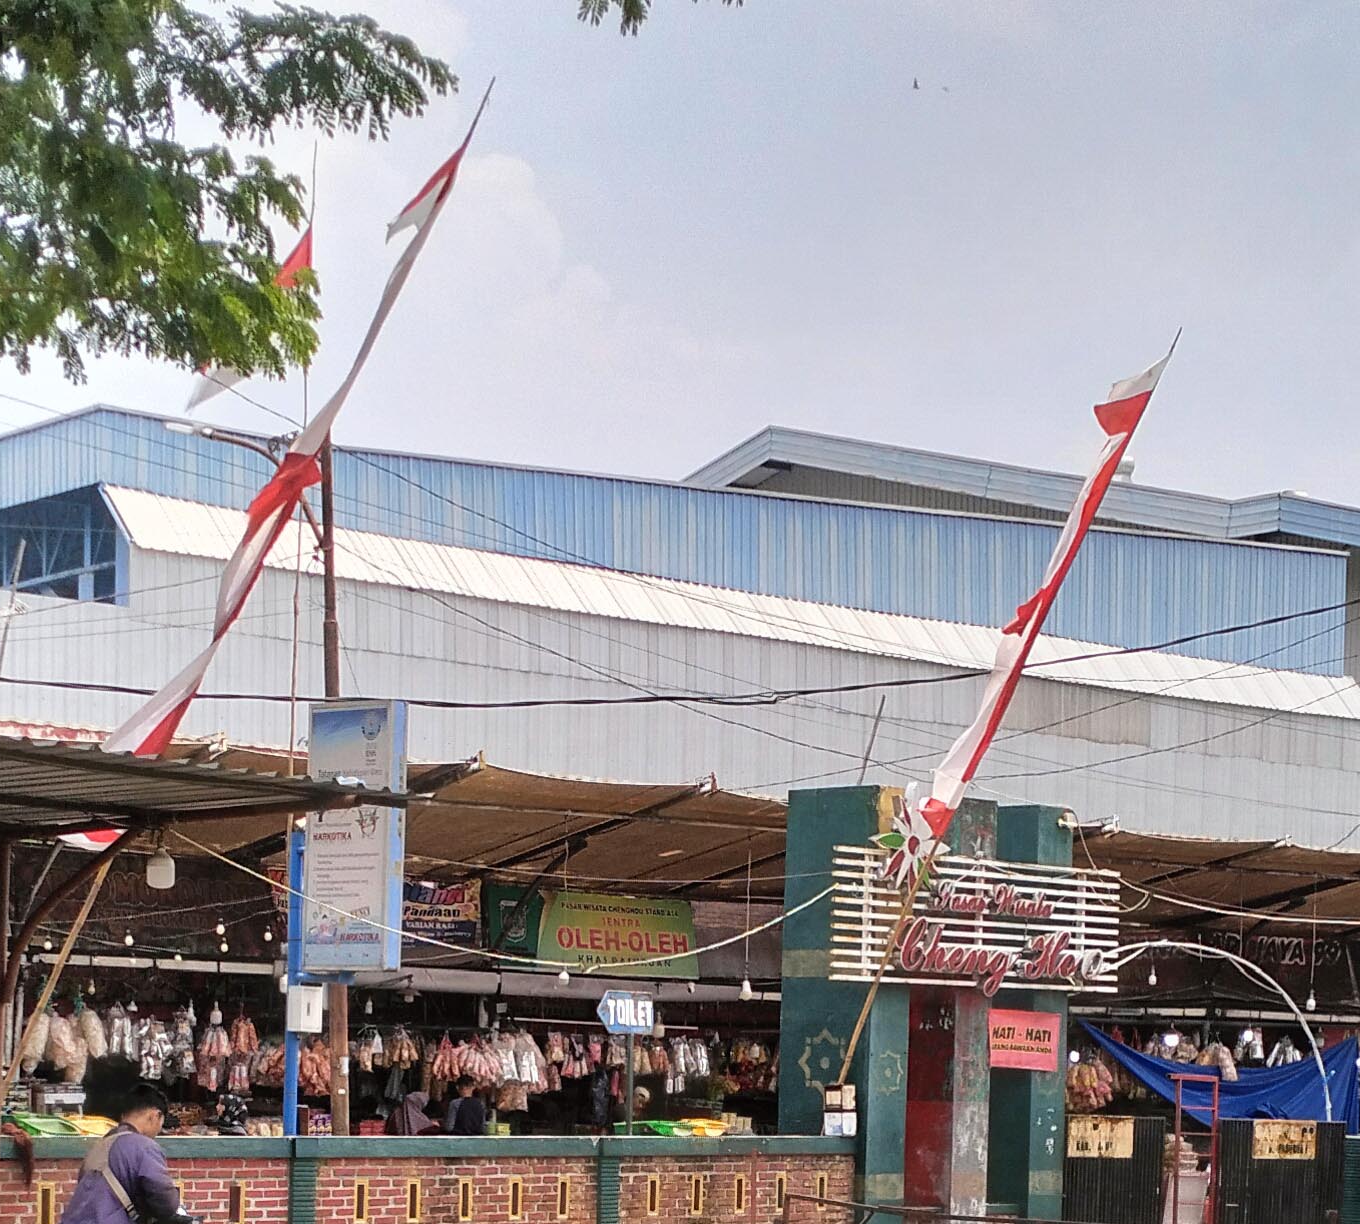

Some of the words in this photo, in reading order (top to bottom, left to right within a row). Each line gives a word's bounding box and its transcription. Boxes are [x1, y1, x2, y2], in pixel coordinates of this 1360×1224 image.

[557, 927, 688, 954] OLEH-OLEH
[895, 916, 1020, 997] Cheng
[607, 998, 653, 1027] TOILET
[992, 1026, 1016, 1040] HATI
[1026, 1028, 1052, 1042] HATI
